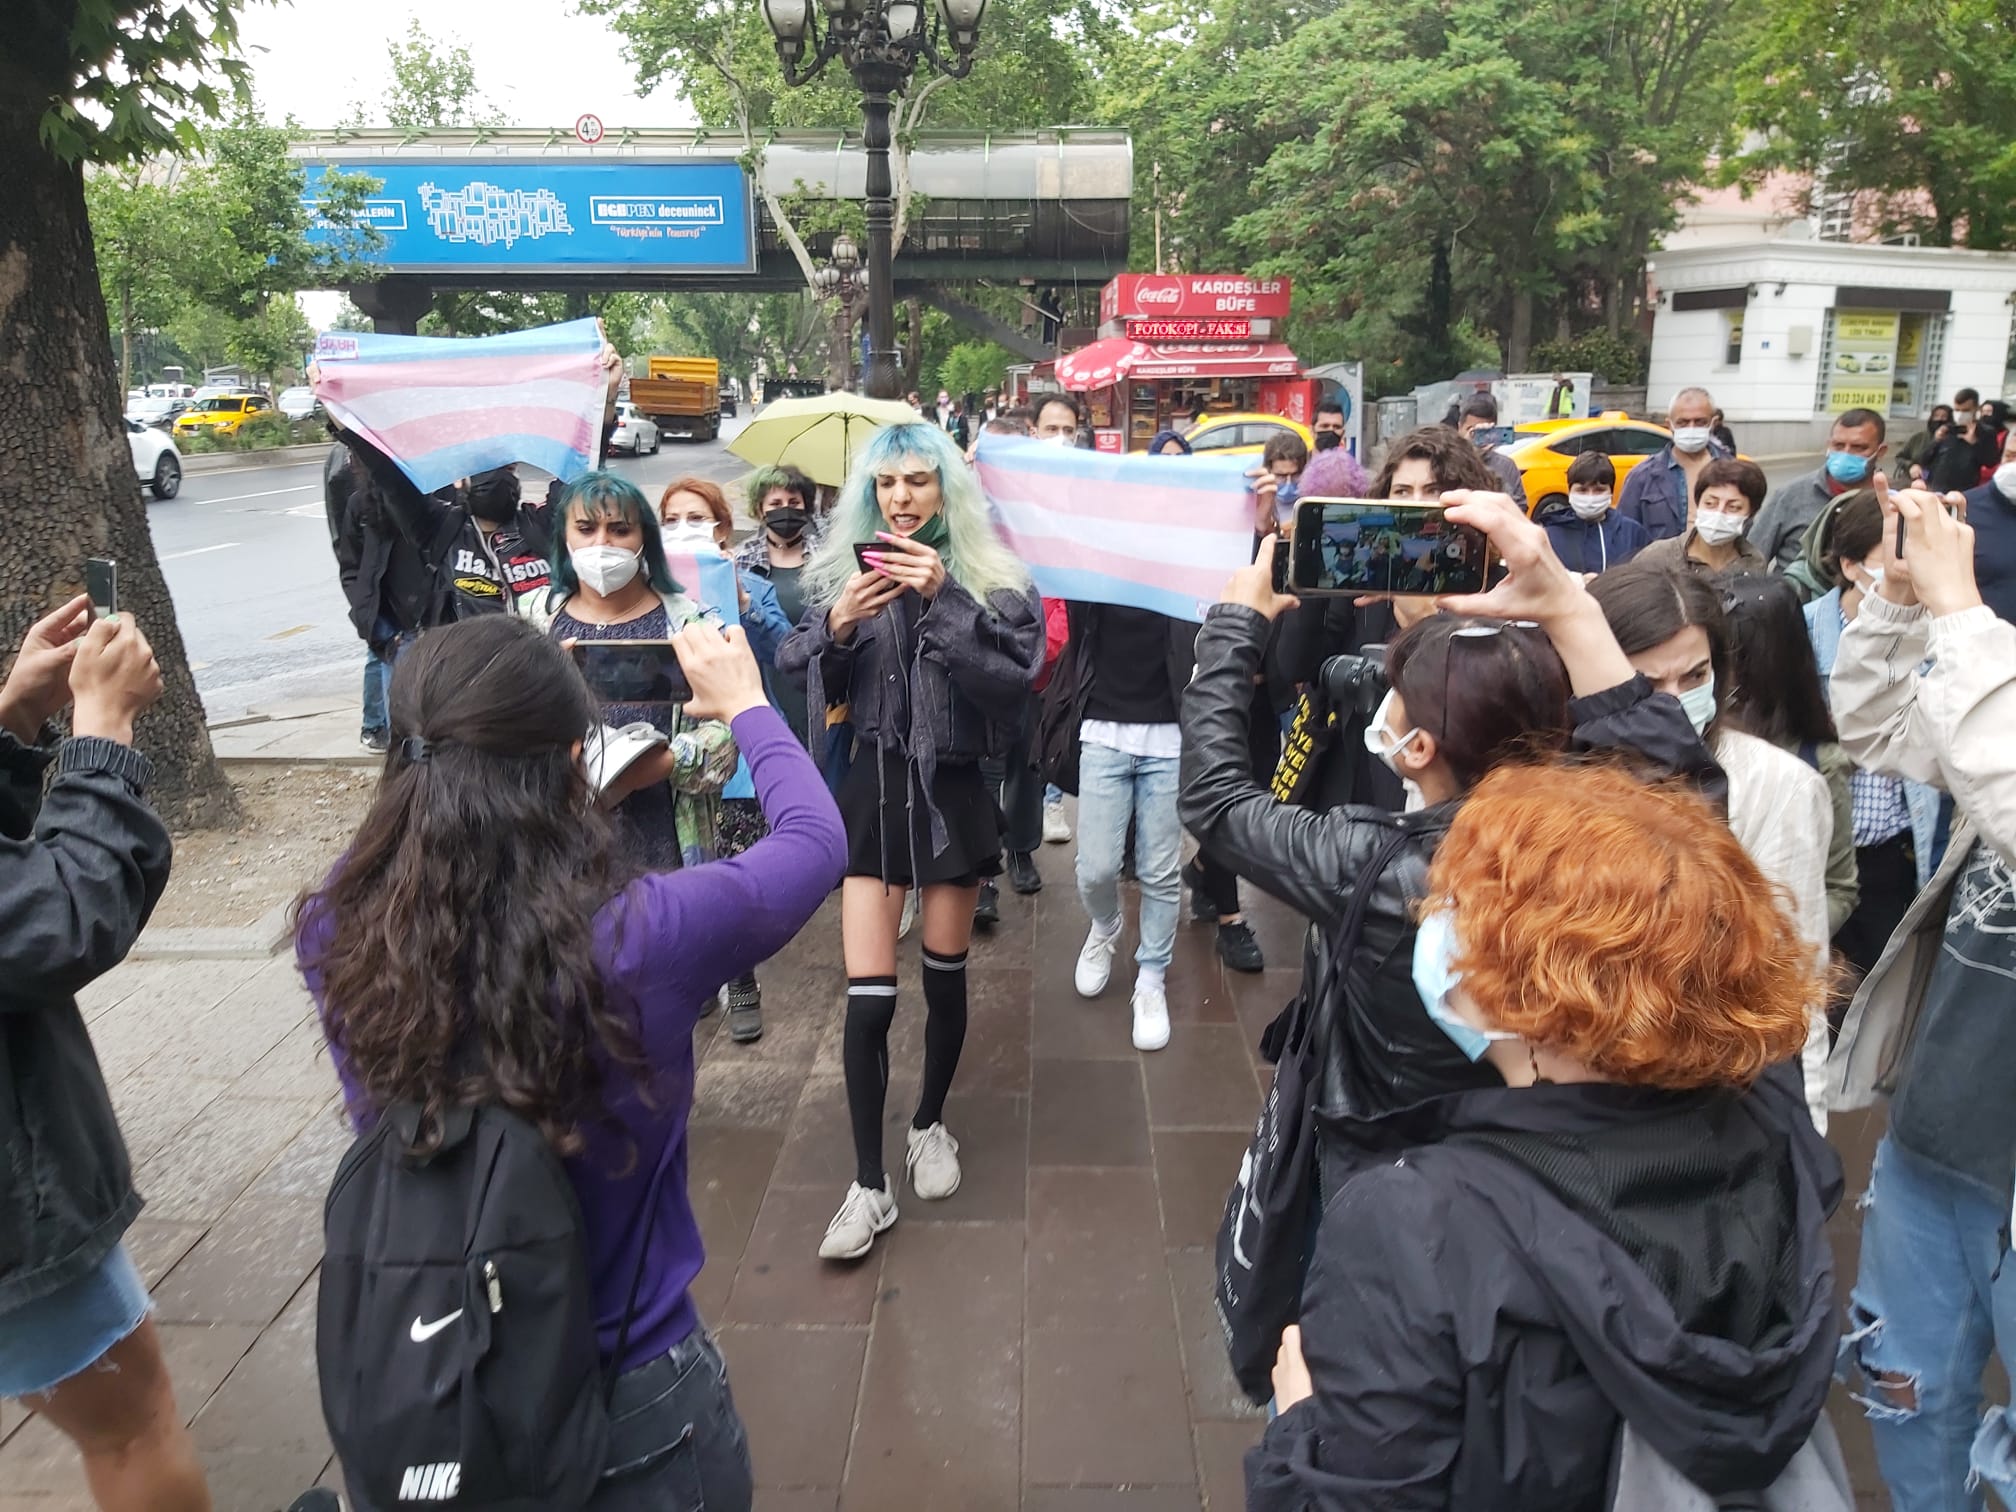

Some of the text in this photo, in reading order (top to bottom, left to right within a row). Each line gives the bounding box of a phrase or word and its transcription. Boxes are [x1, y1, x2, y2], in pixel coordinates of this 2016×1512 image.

[1191, 281, 1281, 296] KARDEŞLER
[1215, 296, 1256, 312] BÜFE
[399, 1461, 461, 1501] NIKE
